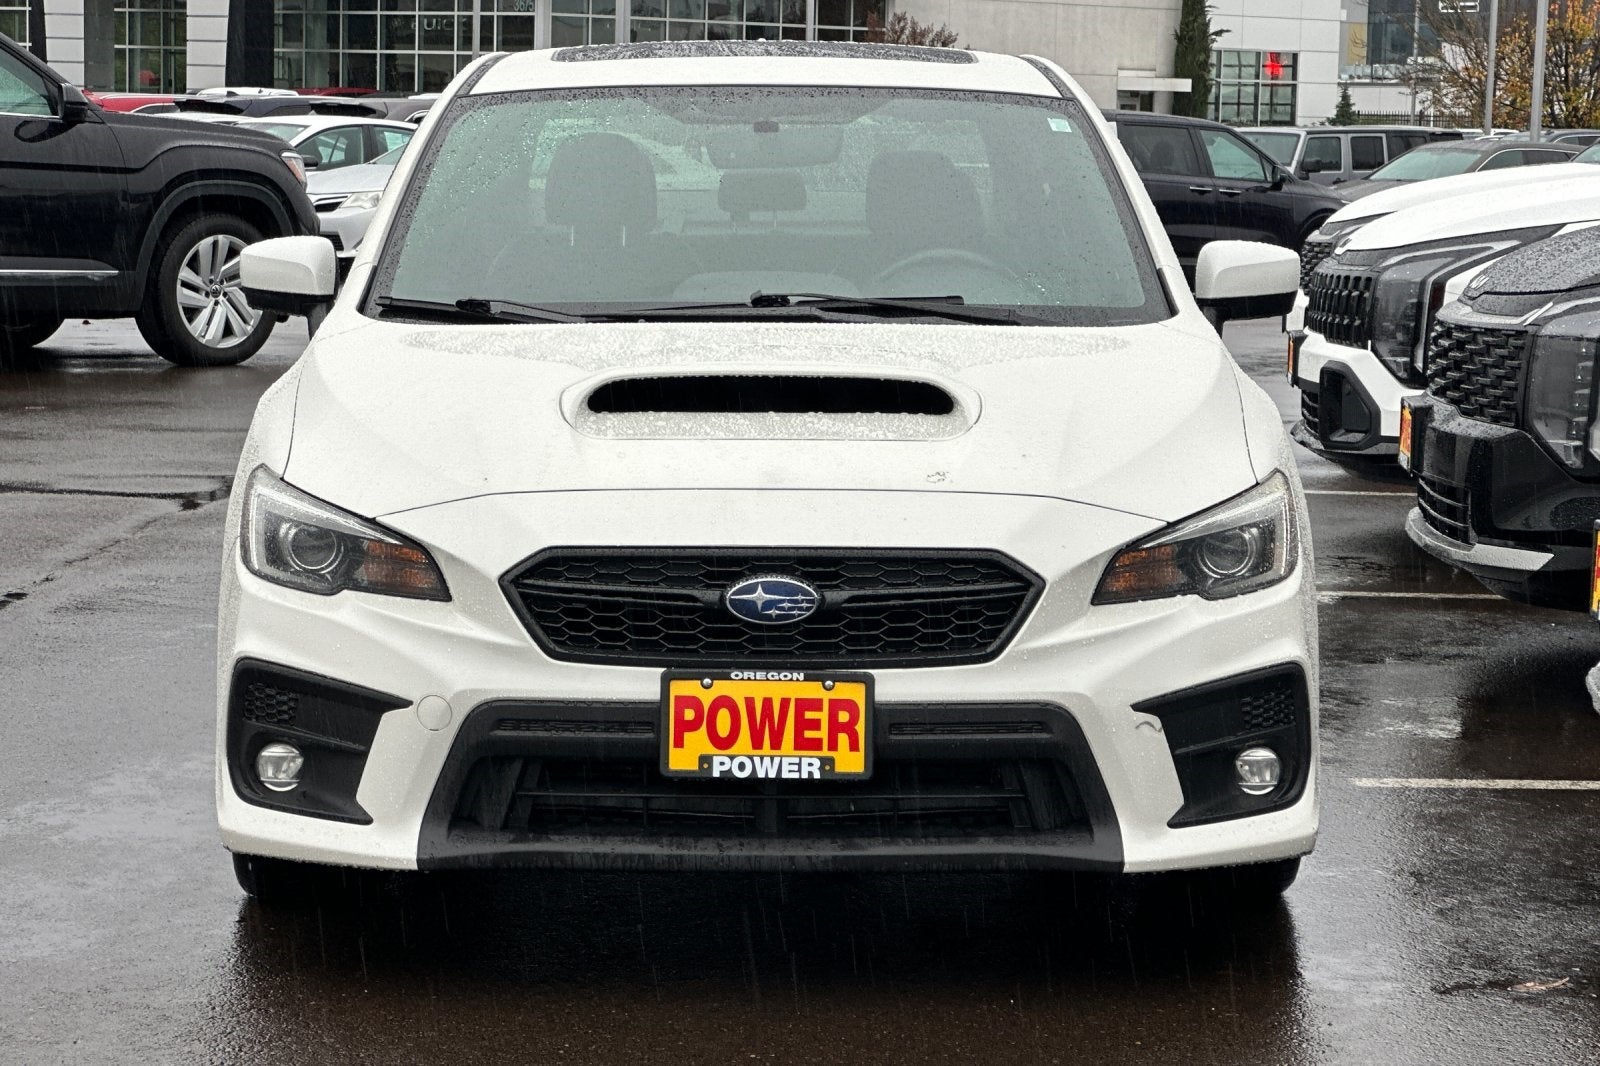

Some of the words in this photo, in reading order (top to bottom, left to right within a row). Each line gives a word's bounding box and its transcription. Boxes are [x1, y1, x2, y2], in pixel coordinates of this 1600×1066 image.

[411, 18, 467, 30] UIC
[730, 671, 805, 681] OREGON
[673, 694, 860, 752] POWER
[712, 755, 821, 779] POWER
